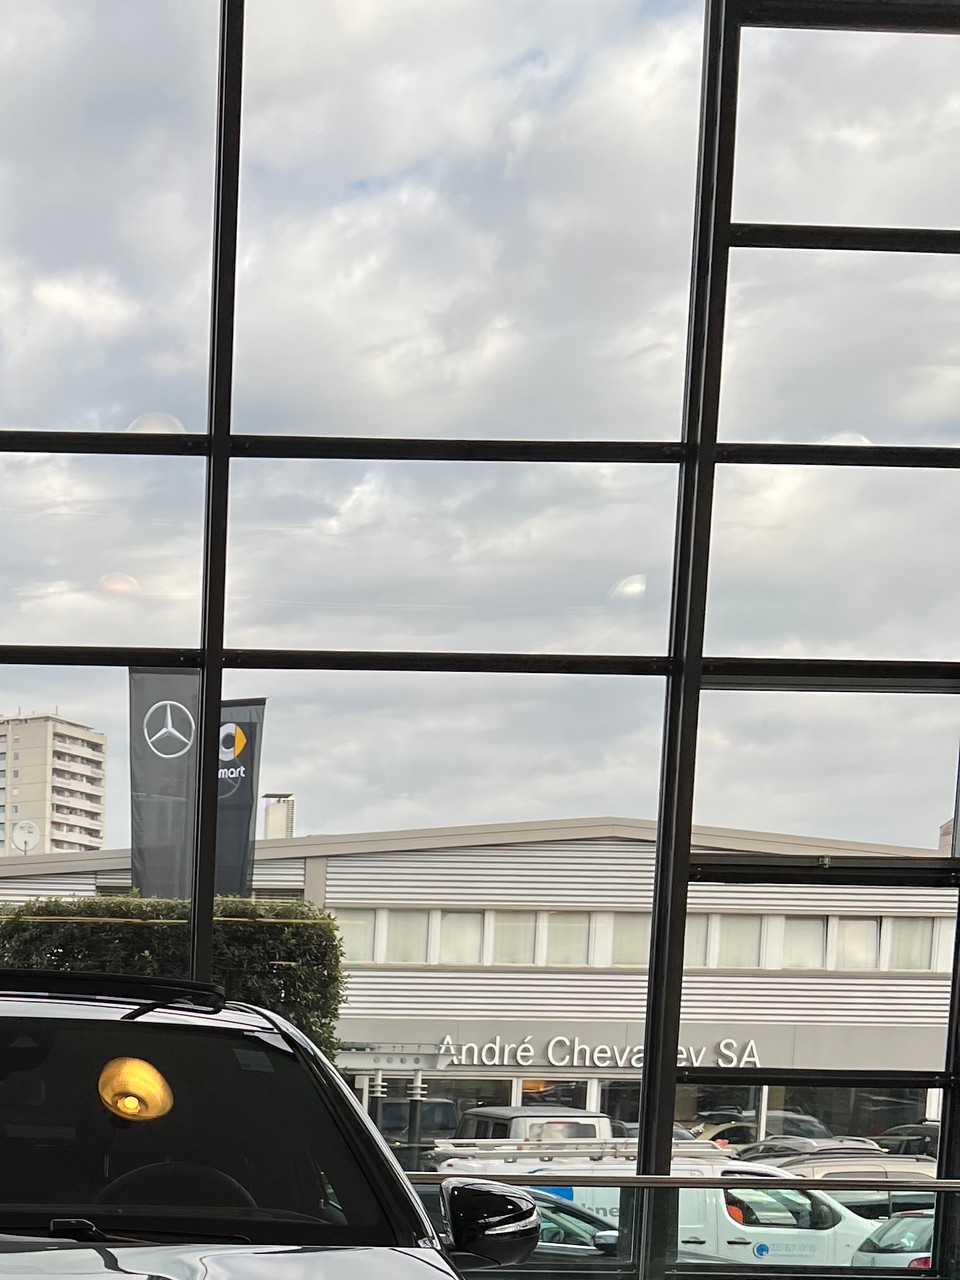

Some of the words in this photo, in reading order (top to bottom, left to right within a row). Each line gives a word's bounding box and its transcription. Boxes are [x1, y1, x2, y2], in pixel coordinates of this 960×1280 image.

[218, 765, 246, 779] mart
[439, 1034, 536, 1067] André
[547, 1035, 707, 1068] Chevaey
[717, 1038, 762, 1069] SA
